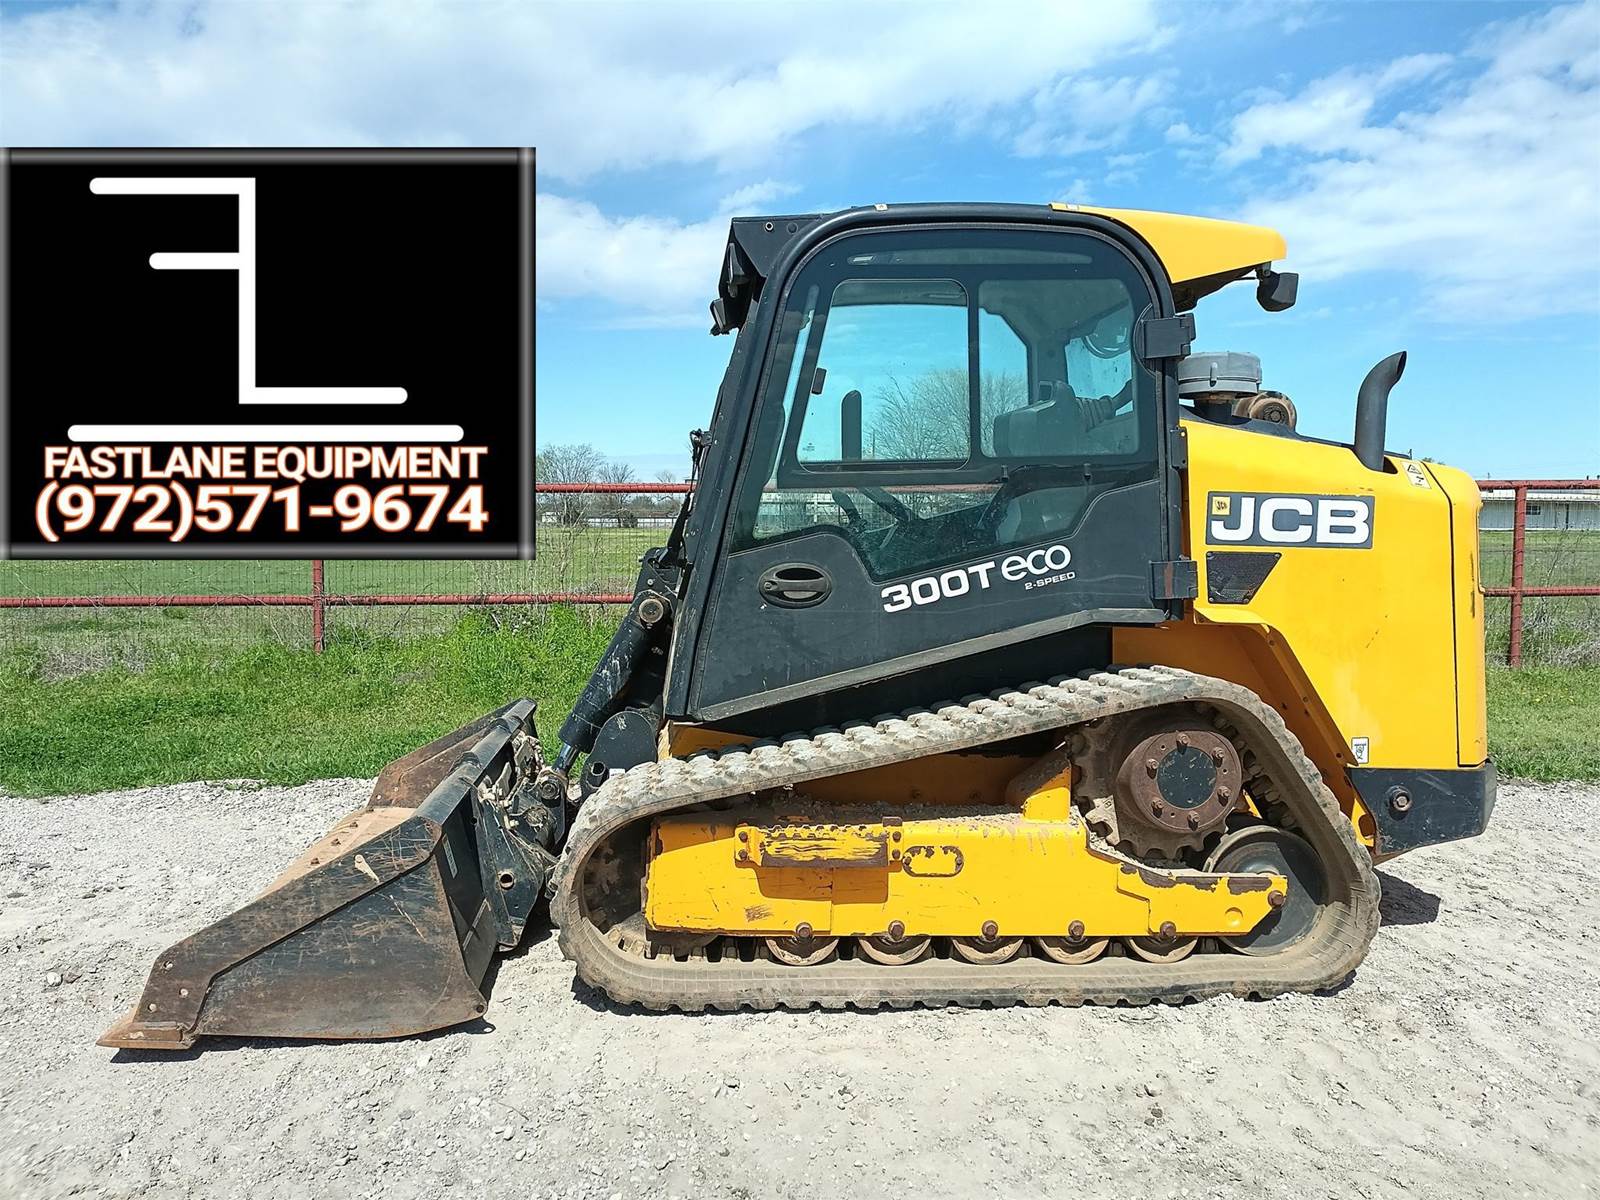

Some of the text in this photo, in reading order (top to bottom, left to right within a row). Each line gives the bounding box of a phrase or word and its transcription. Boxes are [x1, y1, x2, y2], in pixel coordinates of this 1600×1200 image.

[1211, 497, 1370, 544] JCB
[881, 544, 1072, 613] 300T eco
[1024, 571, 1077, 591] 2-SPEED
